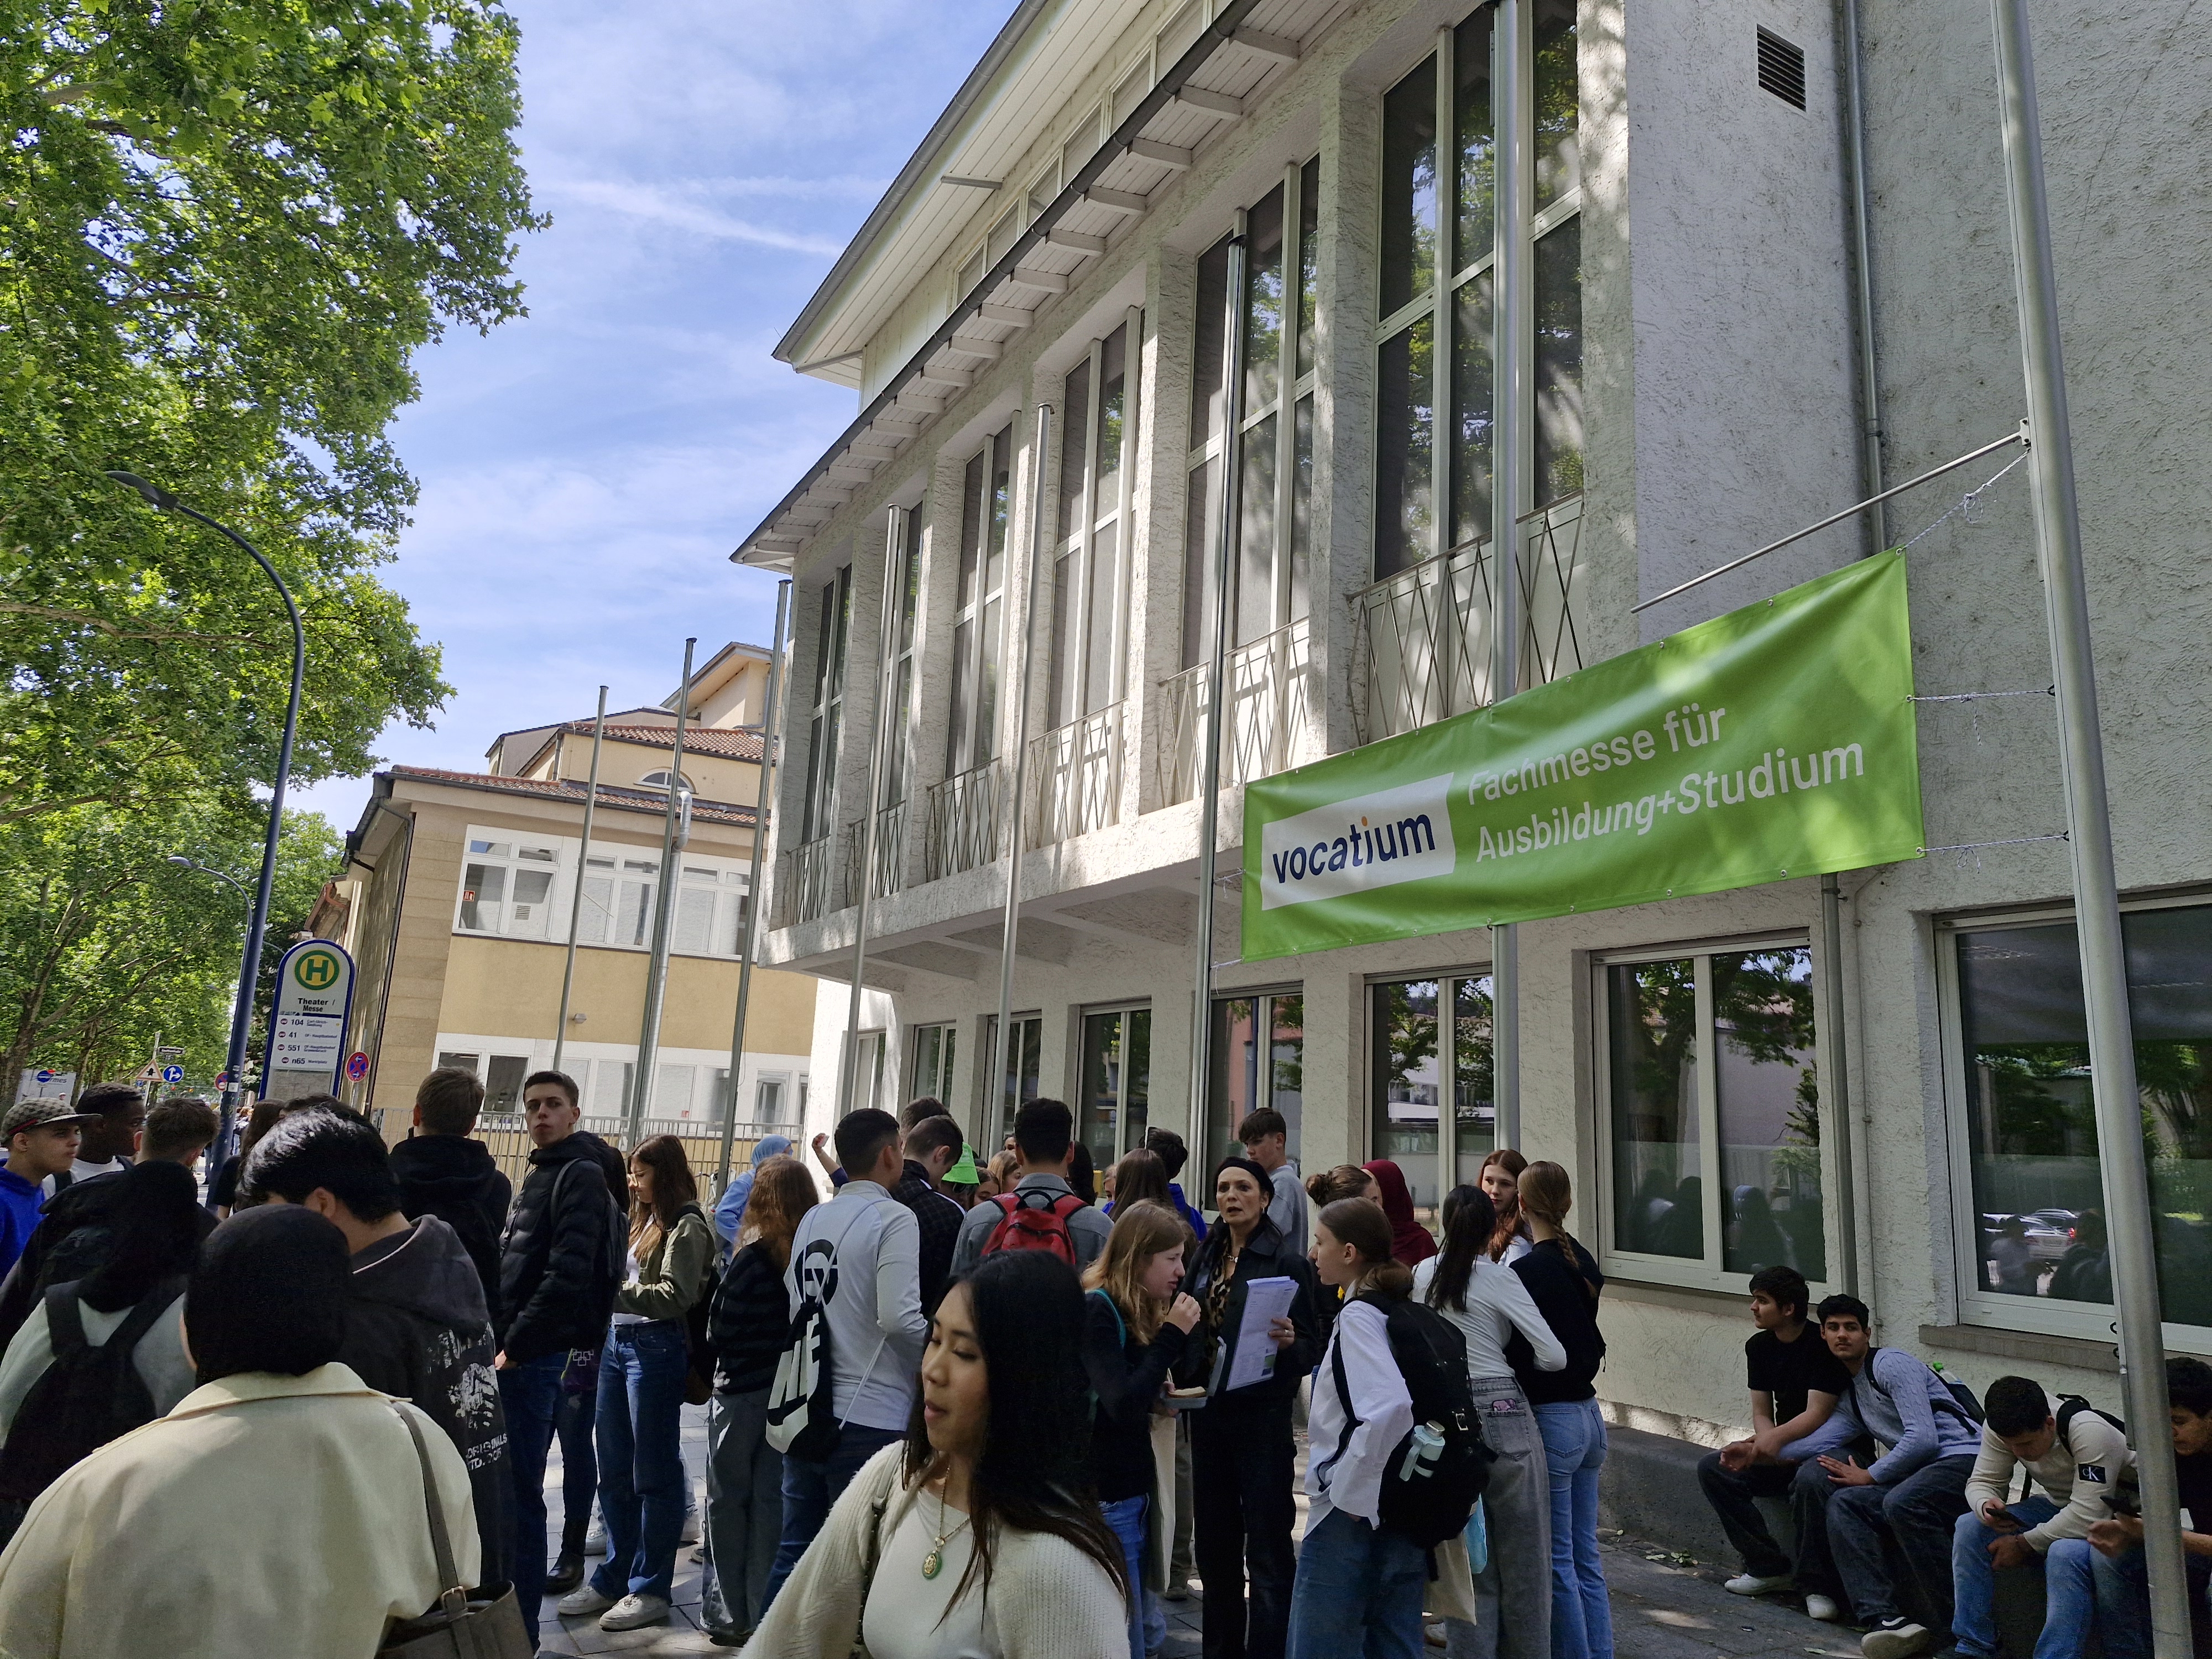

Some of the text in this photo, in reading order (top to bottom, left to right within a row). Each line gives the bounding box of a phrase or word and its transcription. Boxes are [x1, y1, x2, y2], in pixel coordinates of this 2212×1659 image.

[1468, 702, 1726, 805] Fachmesse für
[1475, 742, 1864, 863] Ausbildung+Studium
[1272, 814, 1436, 884] vocatium
[305, 959, 329, 982] H
